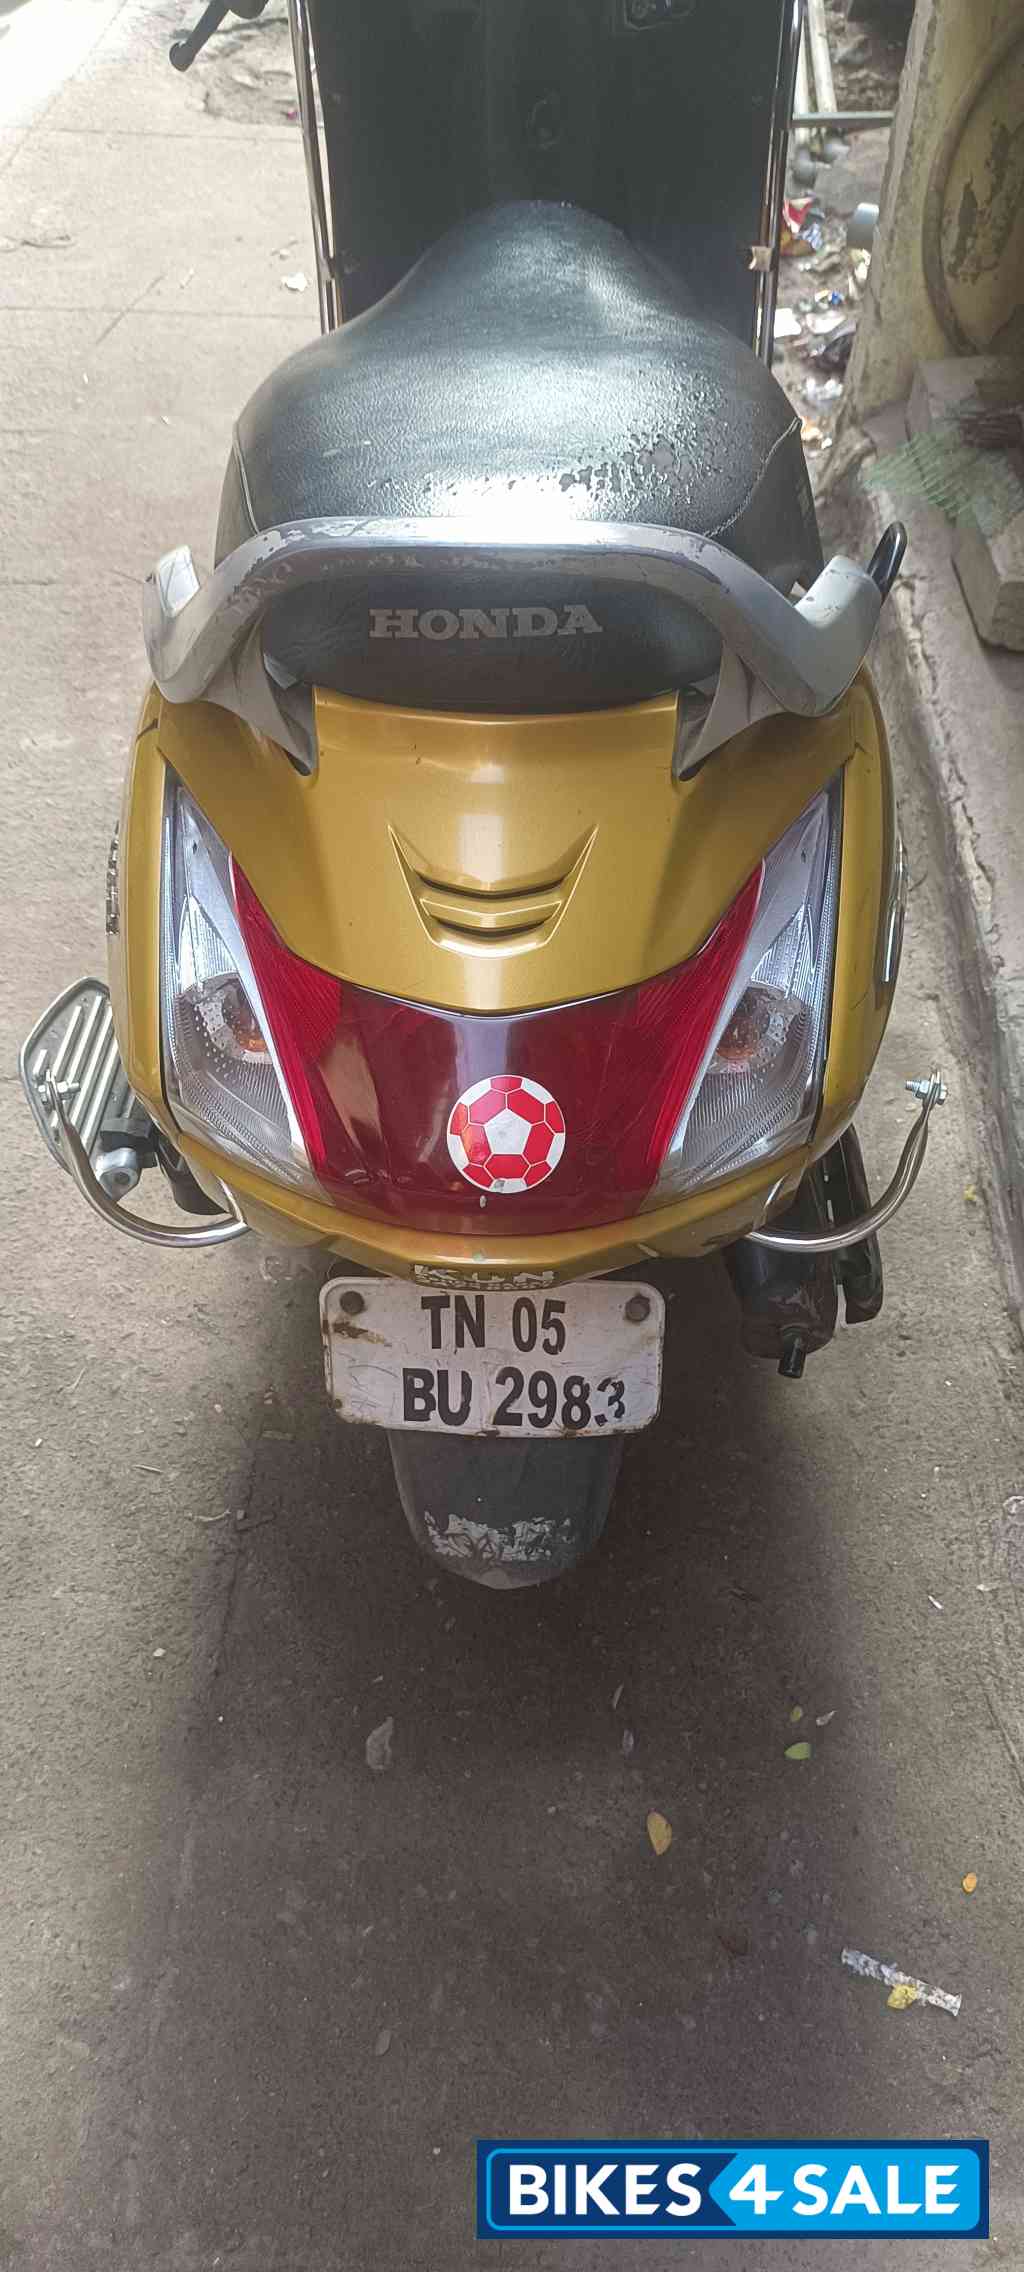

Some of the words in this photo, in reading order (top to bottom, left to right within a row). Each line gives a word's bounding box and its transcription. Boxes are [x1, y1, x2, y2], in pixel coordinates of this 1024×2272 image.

[369, 604, 603, 640] HONDA
[421, 1295, 486, 1349] TN
[512, 1297, 566, 1355] 05
[402, 1367, 473, 1426] BU
[493, 1367, 626, 1429] 2983
